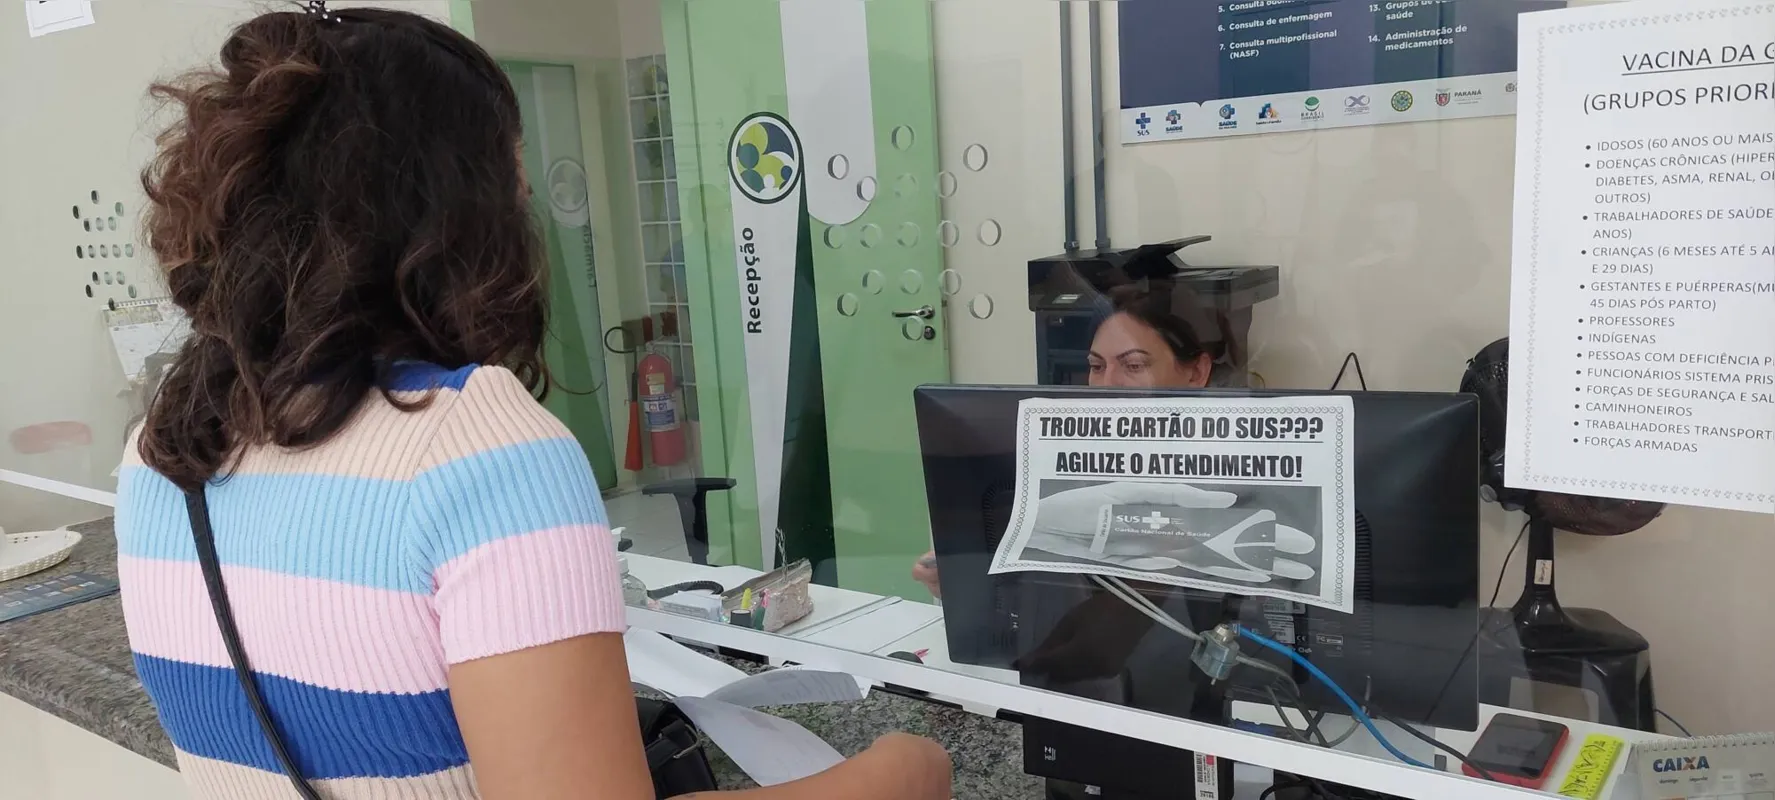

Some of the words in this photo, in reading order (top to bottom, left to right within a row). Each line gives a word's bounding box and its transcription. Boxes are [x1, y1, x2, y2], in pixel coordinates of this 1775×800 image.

[1229, 1, 1264, 11] Consulta
[1386, 0, 1419, 10] Grupos
[1229, 20, 1264, 30] Consulta
[1278, 11, 1332, 24] enfermagem
[1386, 11, 1414, 20] saúde
[1230, 39, 1264, 50] Consulta
[1266, 29, 1338, 45] multiprofissional
[1386, 26, 1452, 40] Administração
[1455, 25, 1468, 33] de
[1385, 38, 1454, 51] medicamentos
[1230, 49, 1259, 60] (NASF)
[1622, 48, 1712, 71] VACINA
[1721, 44, 1756, 64] DA
[1454, 89, 1482, 97] PARANÁ
[1584, 88, 1686, 115] (GRUPOS
[1597, 140, 1644, 151] IDOSOS
[1648, 138, 1667, 152] (60
[1671, 136, 1709, 148] ANOS
[1712, 135, 1732, 146] OU
[1738, 132, 1774, 144] MAIS
[1596, 157, 1656, 171] DOENÇAS
[1660, 154, 1726, 167] CRÔNICAS
[1731, 152, 1774, 166] (HIPER
[1596, 175, 1658, 188] DIABETES,
[1662, 174, 1704, 186] ASMA,
[1709, 172, 1756, 184] RENAL,
[1595, 192, 1651, 204] OUTROS)
[1594, 210, 1702, 222] TRABALHADORES
[1707, 210, 1724, 220] DE
[1728, 206, 1774, 219] SAÚDE
[1593, 228, 1632, 240] ANOS)
[1592, 246, 1653, 260] CRIANÇAS
[1658, 246, 1670, 258] (6
[1674, 246, 1716, 256] MESES
[1720, 244, 1745, 256] ATÉ
[1750, 246, 1757, 256] 5
[1592, 264, 1598, 274] E
[1602, 264, 1617, 274] 29
[1620, 264, 1654, 275] DIAS)
[739, 227, 762, 334] Recepção
[1591, 282, 1660, 292] GESTANTES
[1666, 282, 1672, 292] E
[1590, 299, 1605, 308] 45
[1608, 299, 1636, 309] DIAS
[1640, 296, 1665, 310] PÓS
[1669, 300, 1716, 312] PARTO)
[1590, 316, 1675, 327] PROFESSORES
[1588, 332, 1656, 344] INDÍGENAS
[1588, 351, 1640, 362] PESSOAS
[1645, 352, 1674, 362] COM
[1680, 353, 1759, 366] DEFICIÊNCIA
[1764, 357, 1774, 366] P
[1588, 366, 1681, 381] FUNCIONÁRIOS
[1685, 372, 1740, 384] SISTEMA
[1746, 374, 1774, 385] PRIS
[1586, 385, 1633, 398] FORÇAS
[1638, 388, 1653, 397] DE
[1658, 388, 1736, 403] SEGURANÇA
[1740, 392, 1746, 401] E
[1752, 392, 1774, 403] SAL
[1586, 402, 1692, 417] CAMINHONEIROS
[1040, 416, 1111, 438] TROUXE
[1116, 412, 1196, 439] CARTÃO
[1202, 416, 1230, 439] DO
[1236, 416, 1324, 440] SUS???
[1584, 419, 1690, 434] TRABALHADORES
[1695, 424, 1774, 440] TRANSPORT
[1584, 436, 1631, 450] FORÇAS
[1635, 440, 1698, 453] ARMADAS
[1056, 452, 1126, 474] AGILIZE
[1130, 453, 1144, 474] O
[1148, 454, 1302, 478] ATENDIMENTO!
[1116, 514, 1140, 523] SUS
[1653, 756, 1710, 772] CAIXA
